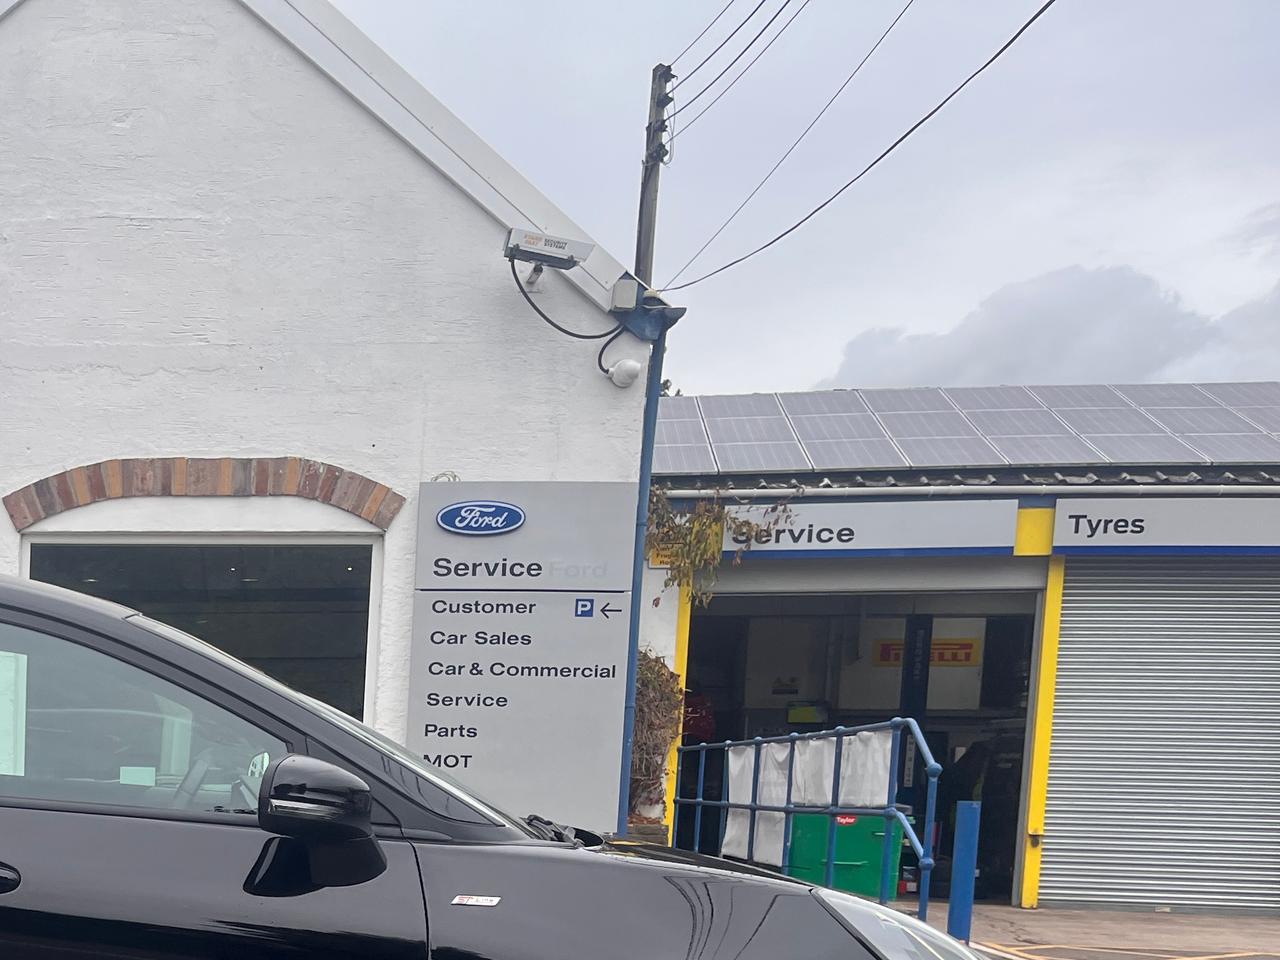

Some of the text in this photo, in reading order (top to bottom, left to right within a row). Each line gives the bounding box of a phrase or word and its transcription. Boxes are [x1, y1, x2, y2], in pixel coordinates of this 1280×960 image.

[454, 506, 508, 528] Ford
[1068, 514, 1145, 538] Tyres
[432, 558, 543, 578] Service
[431, 600, 537, 615] Customer
[576, 600, 592, 616] P
[430, 631, 532, 646] Car Sales
[428, 662, 617, 678] Car & Commercial
[426, 692, 508, 708] Service
[424, 723, 478, 738] Parts
[423, 754, 473, 768] MOT
